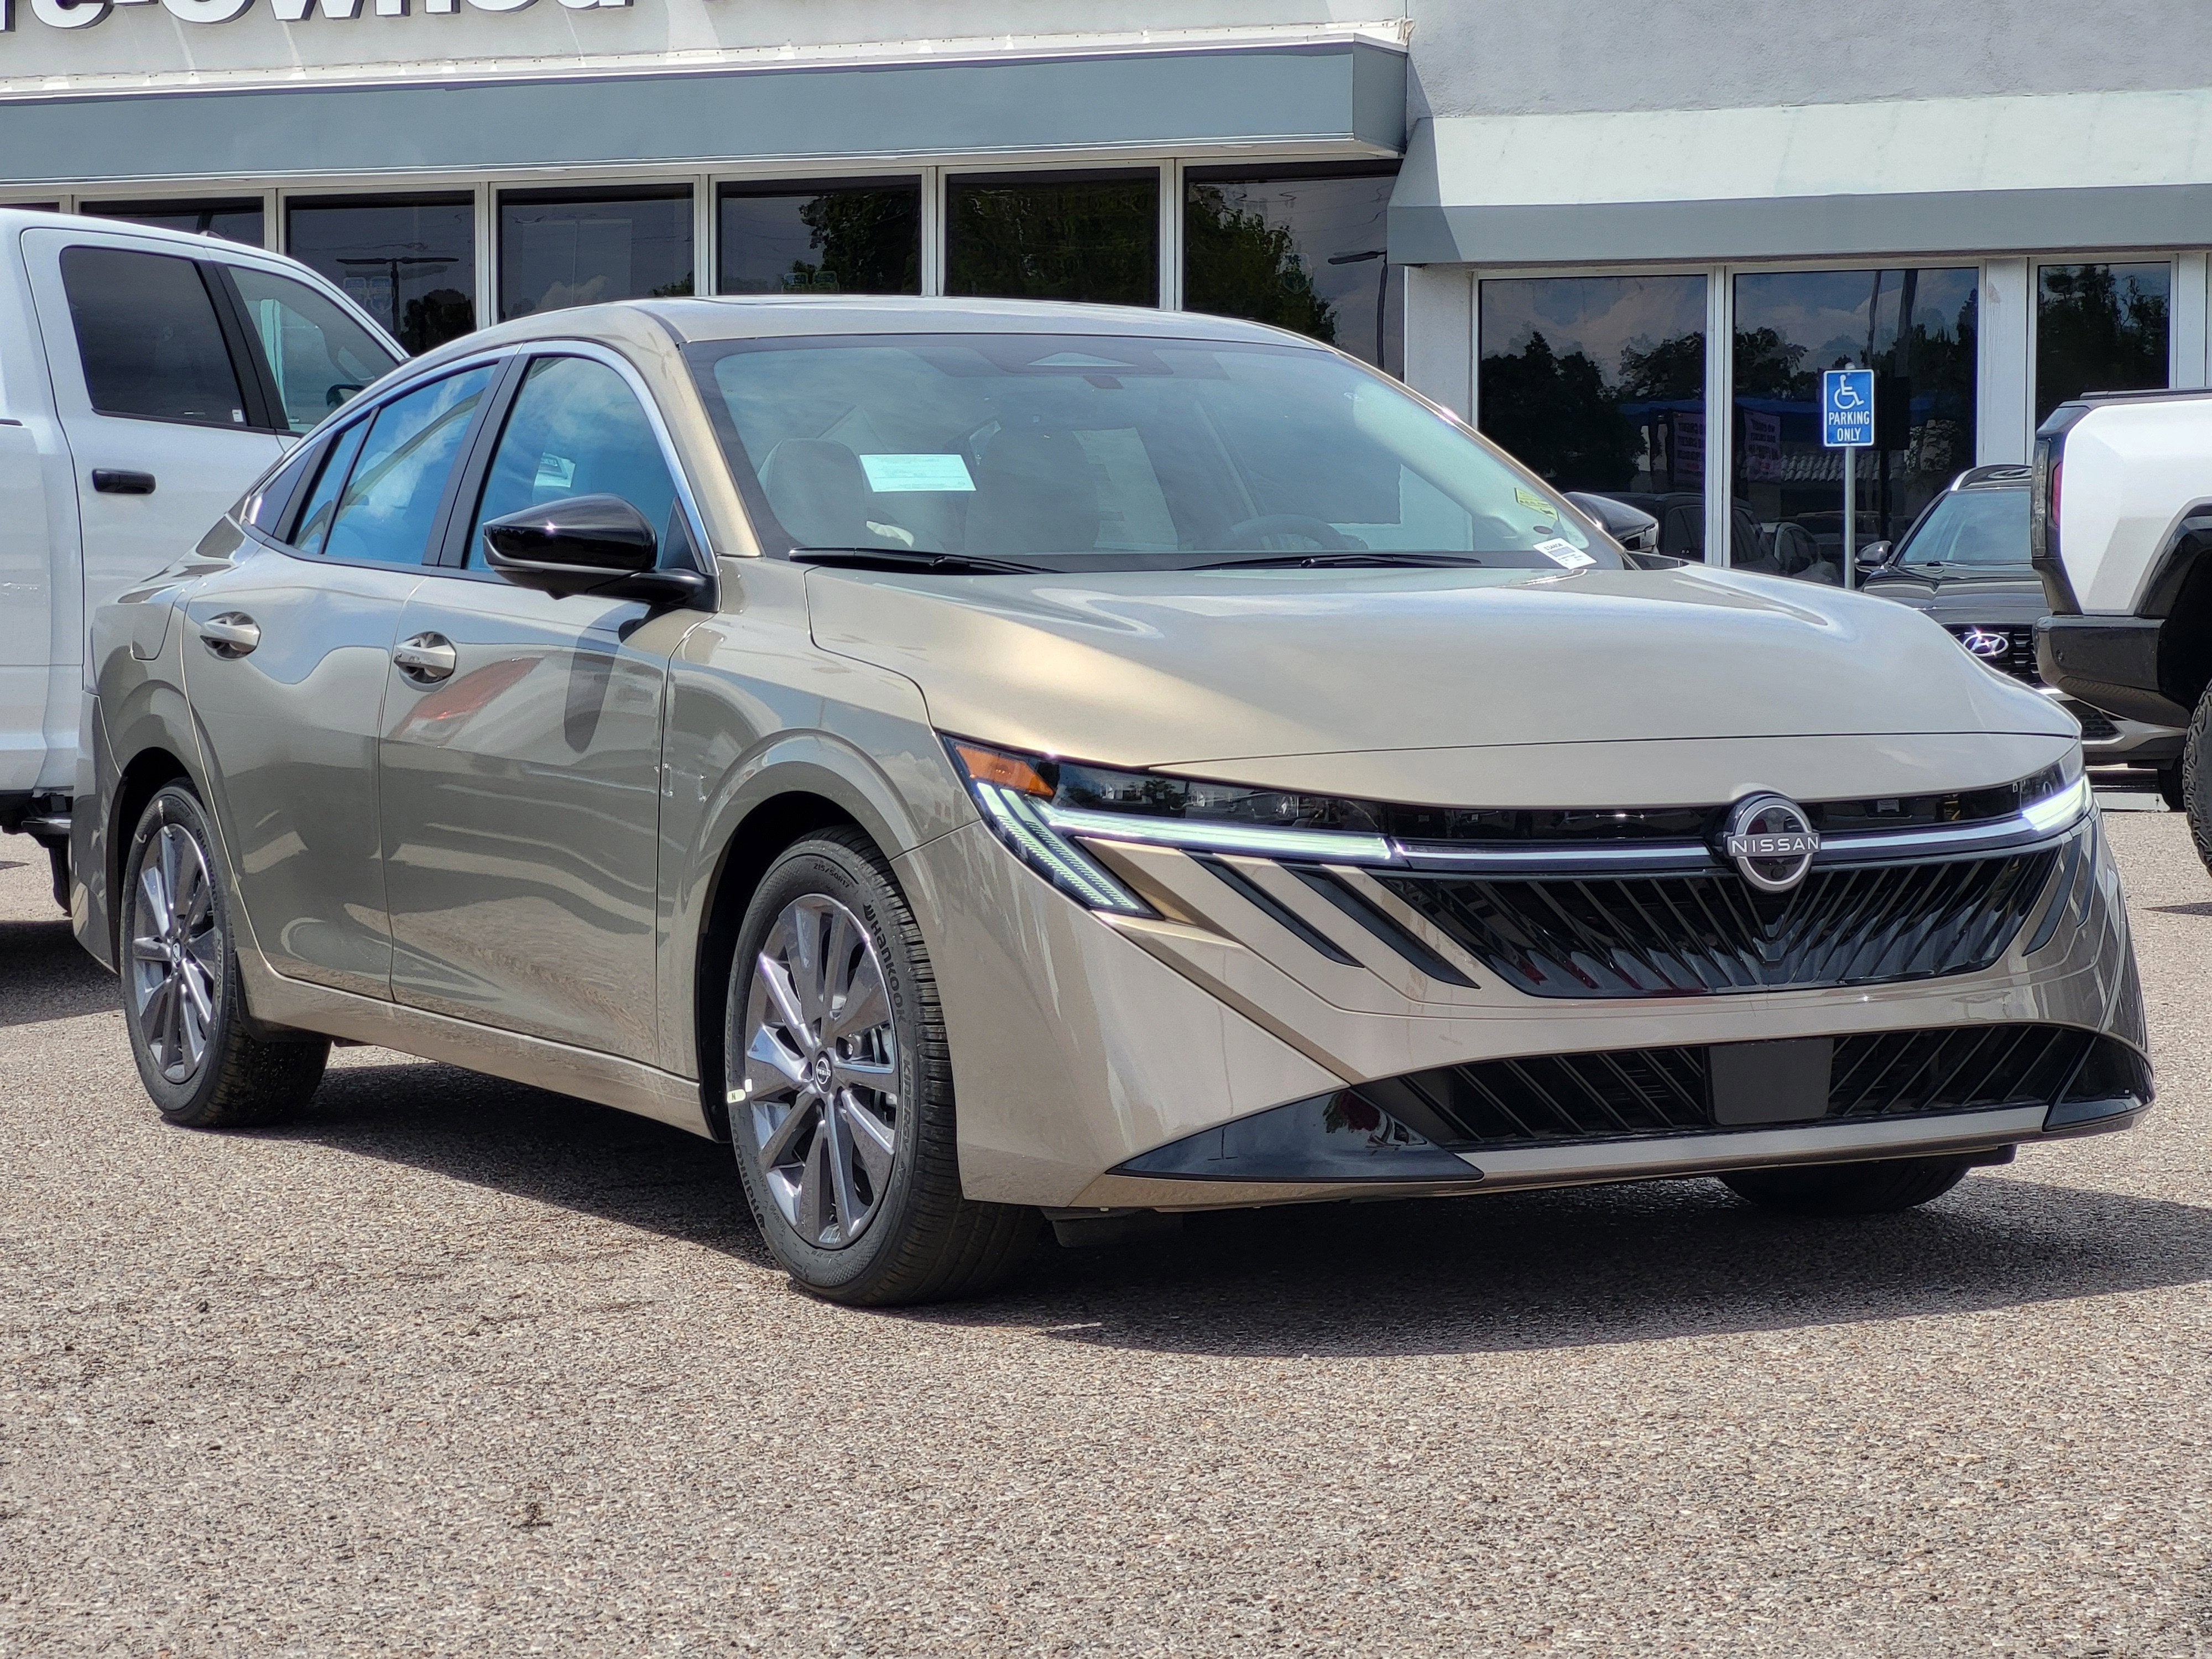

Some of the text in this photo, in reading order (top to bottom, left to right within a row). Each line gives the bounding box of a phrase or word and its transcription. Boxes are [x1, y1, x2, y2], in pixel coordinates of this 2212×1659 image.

[1828, 411, 1870, 425] PARKING
[1837, 427, 1861, 441] ONLY
[1732, 837, 1819, 853] NISSAN
